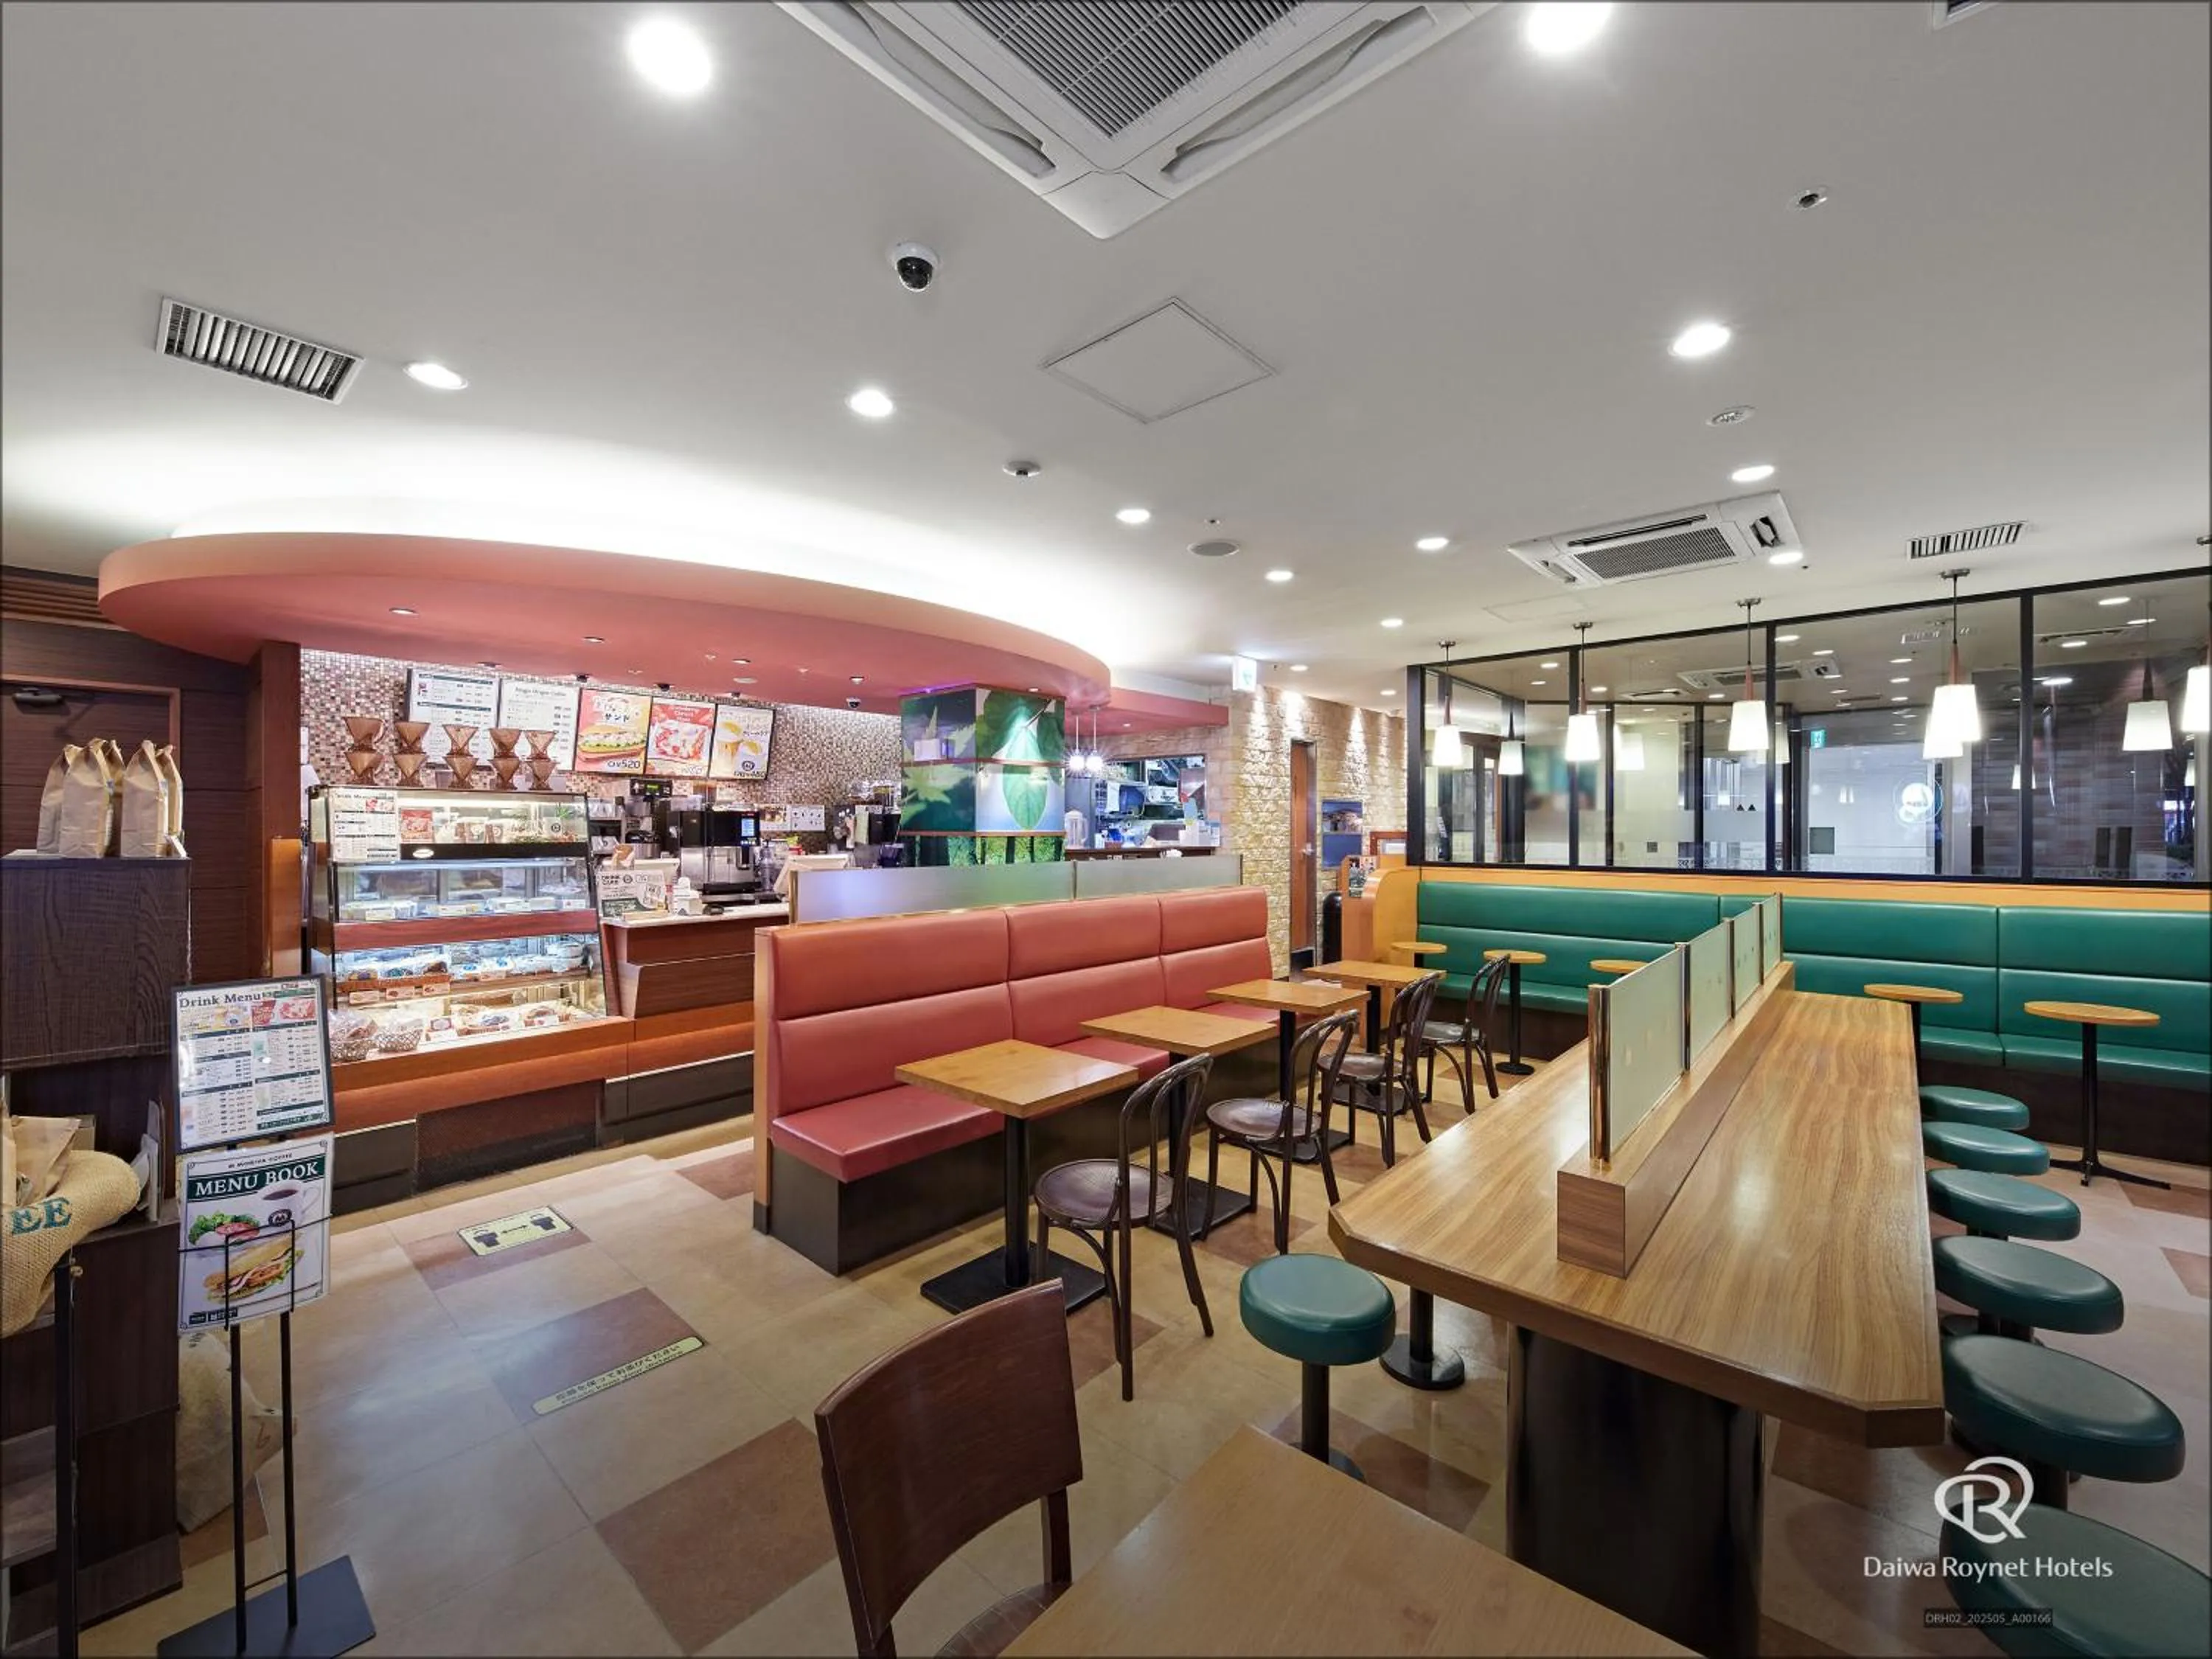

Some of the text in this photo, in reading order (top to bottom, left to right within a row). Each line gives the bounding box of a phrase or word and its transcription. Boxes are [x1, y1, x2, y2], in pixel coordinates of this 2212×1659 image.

[180, 995, 219, 1008] Drink
[224, 992, 261, 1004] Menu
[195, 1161, 319, 1197] MENU BOOK
